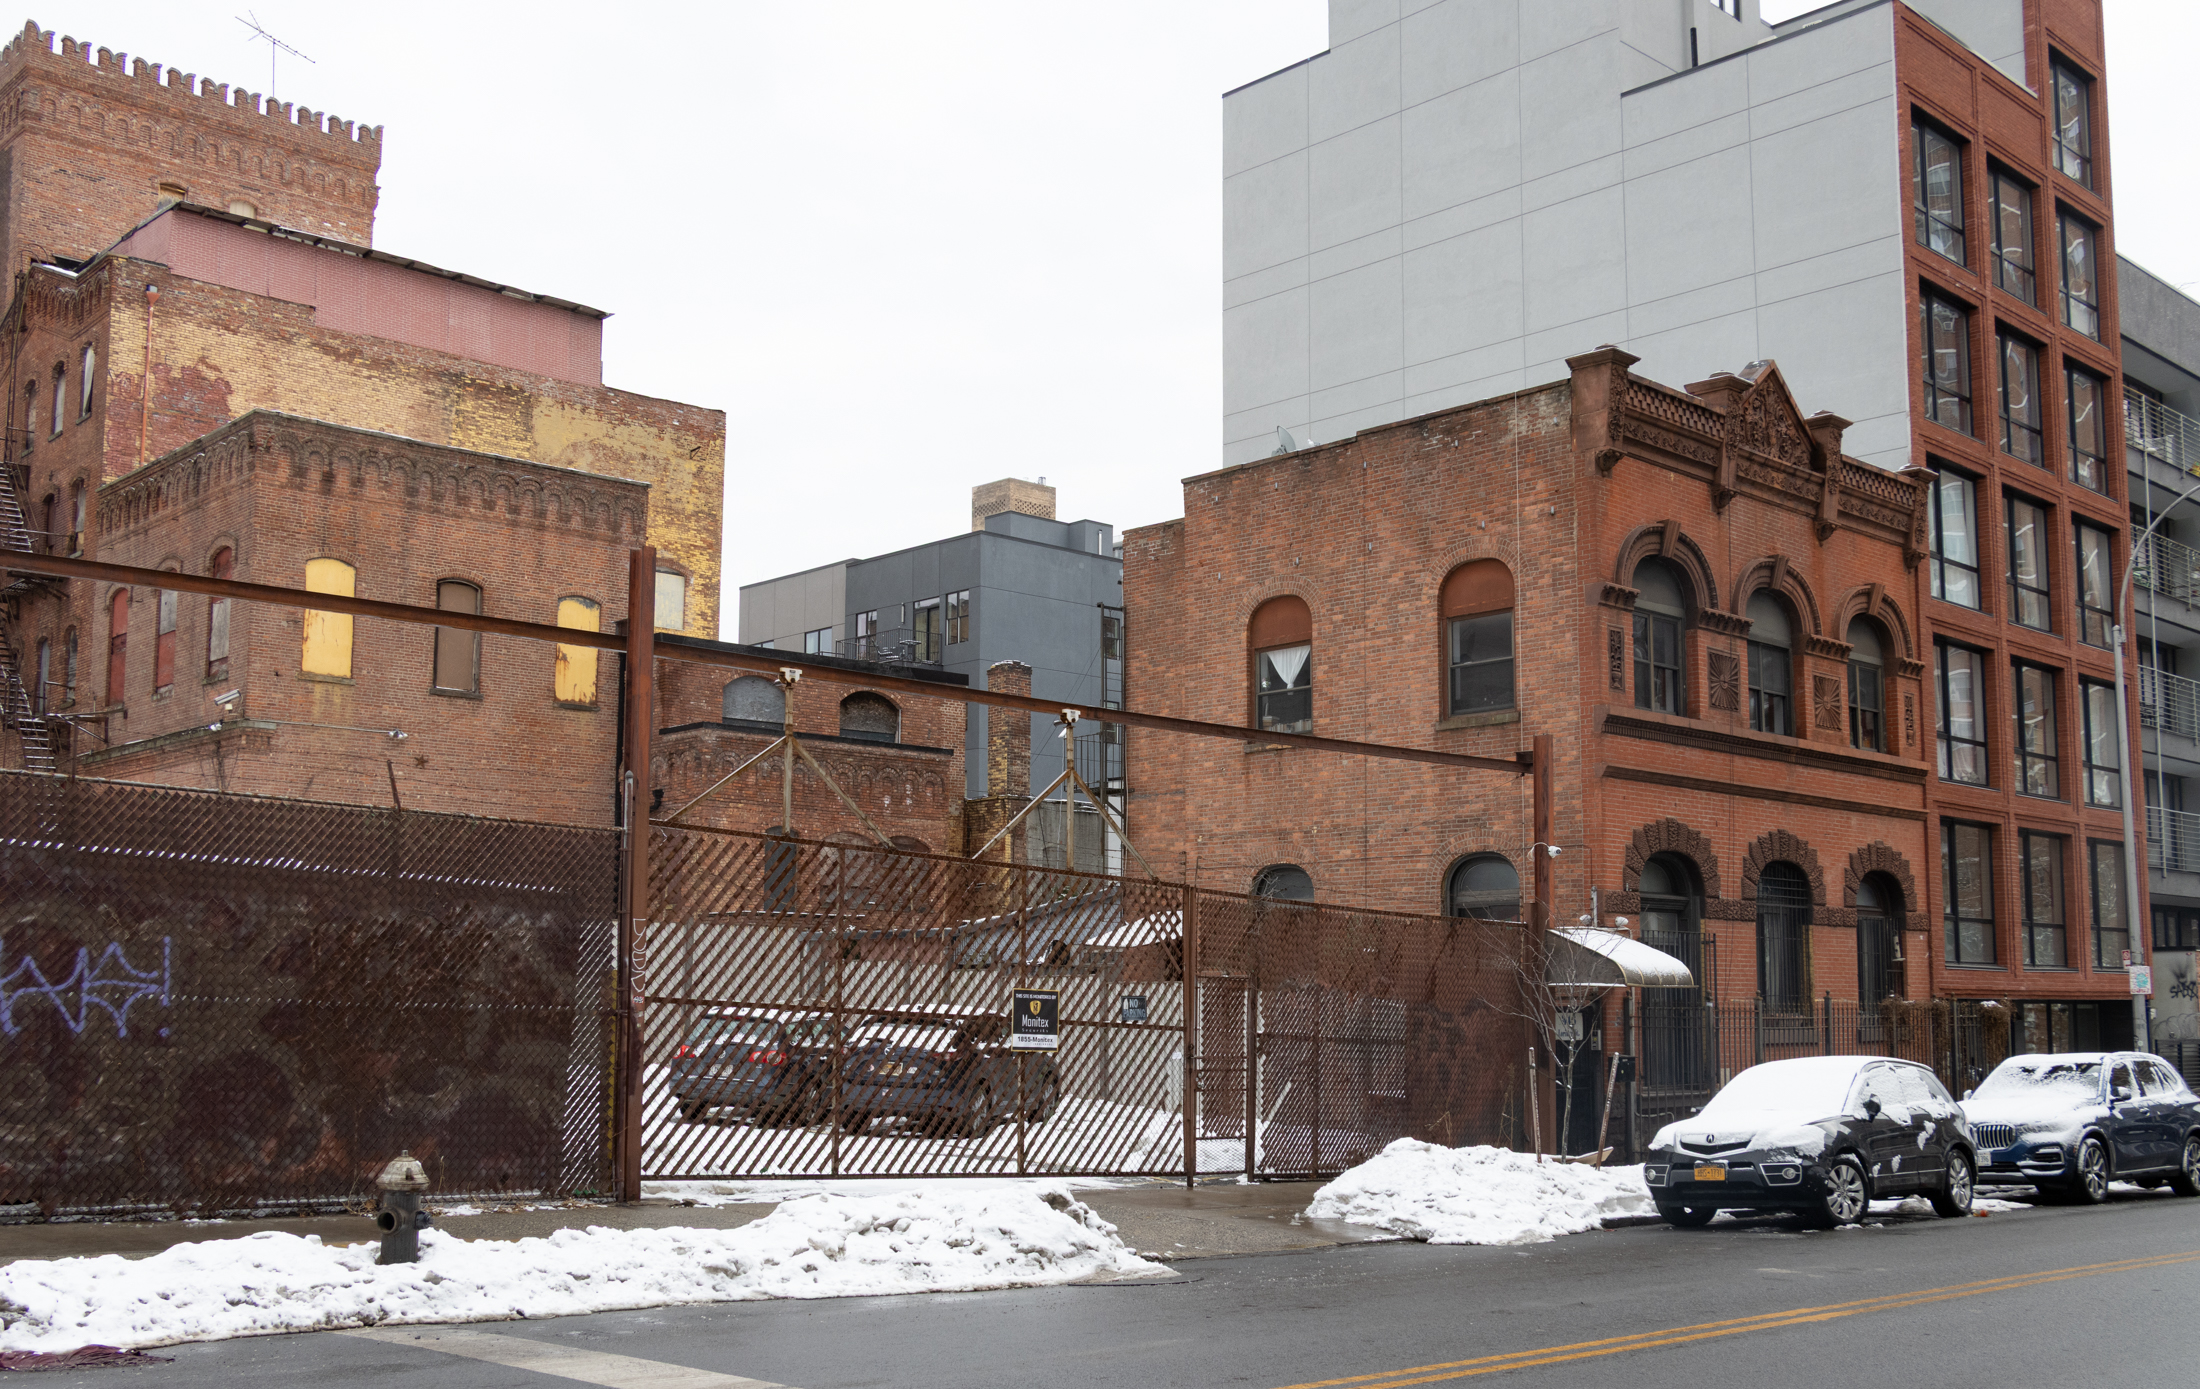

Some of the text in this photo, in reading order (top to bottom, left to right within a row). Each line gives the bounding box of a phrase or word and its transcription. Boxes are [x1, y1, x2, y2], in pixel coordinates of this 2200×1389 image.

[1129, 998, 1138, 1008] NO
[1123, 1008, 1146, 1018] PARKING
[1022, 1014, 1049, 1027] Monitex
